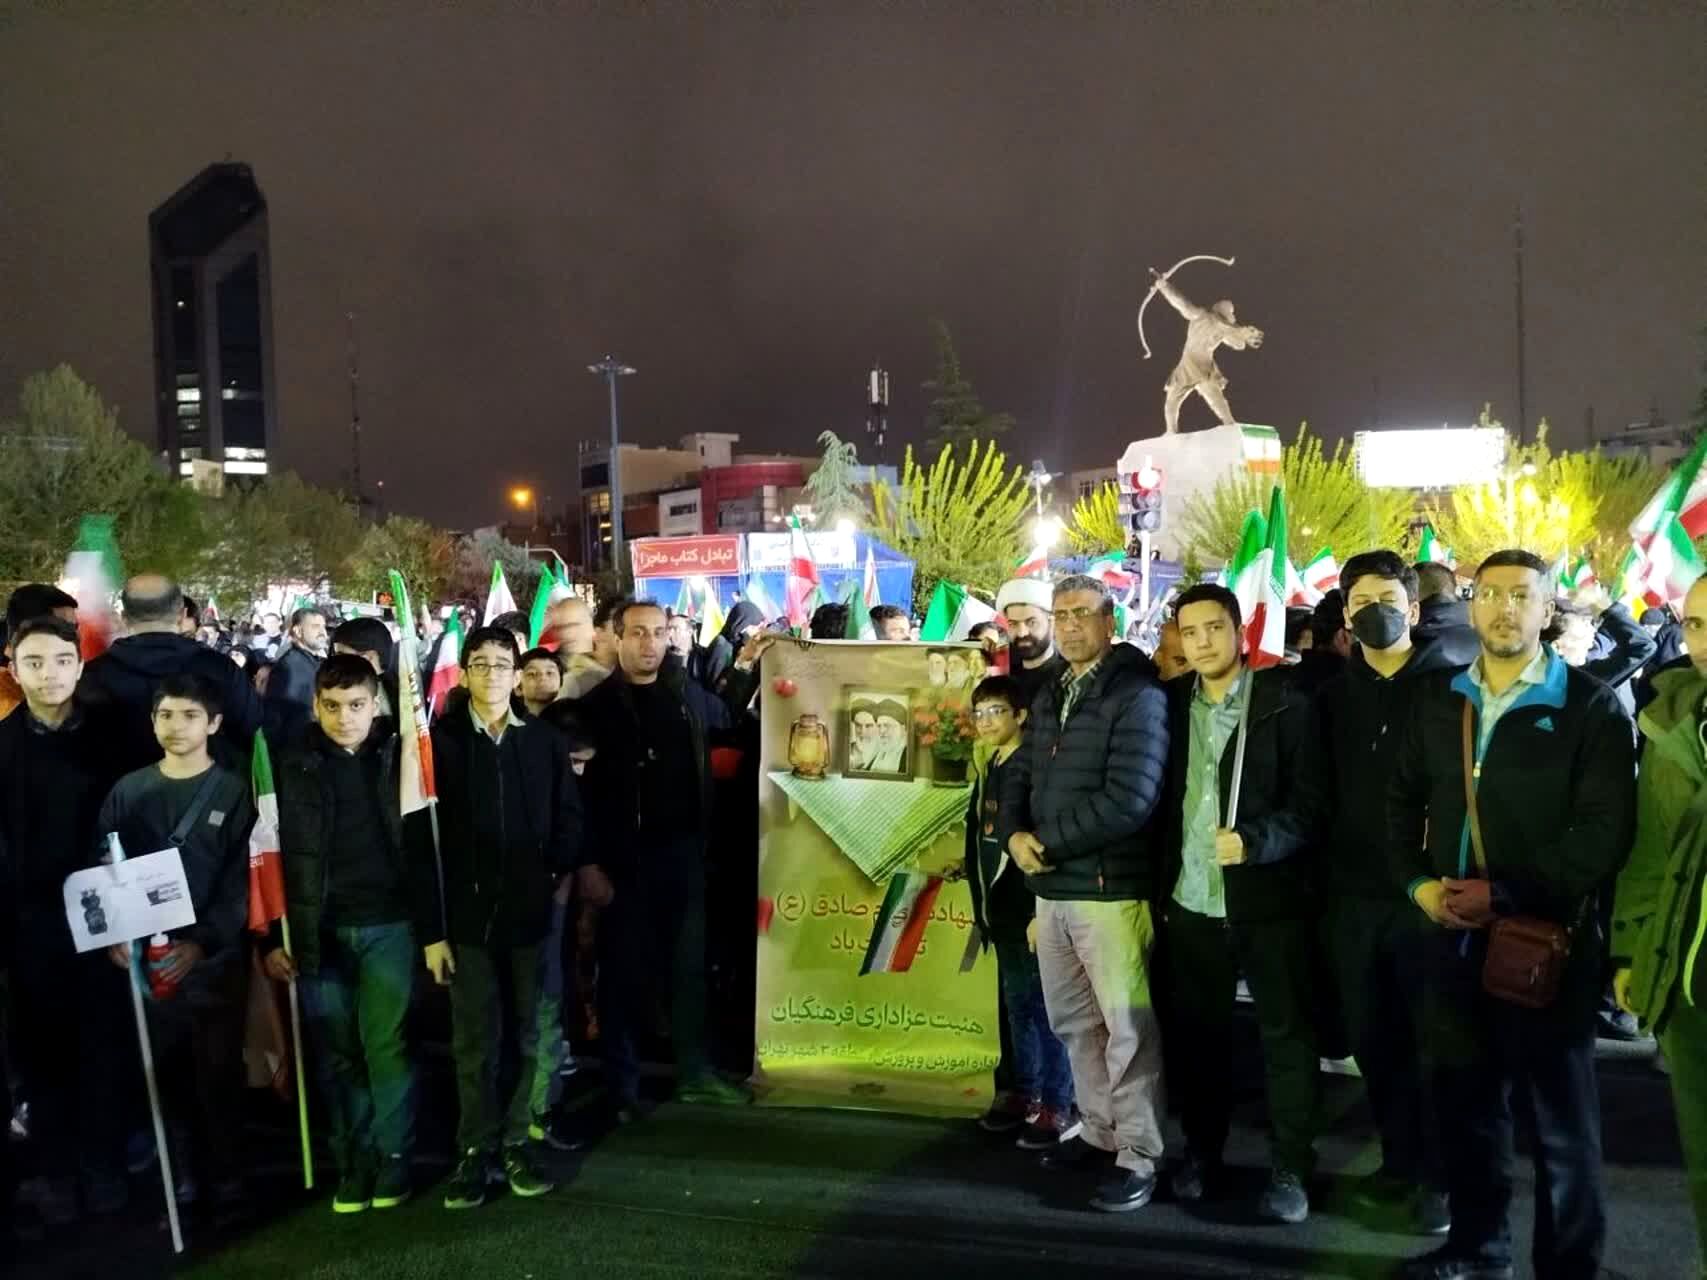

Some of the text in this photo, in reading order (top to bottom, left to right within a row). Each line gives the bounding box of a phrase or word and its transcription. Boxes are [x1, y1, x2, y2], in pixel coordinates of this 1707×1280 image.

[670, 548, 699, 567] کتاب
[701, 547, 734, 566] تبادل
[776, 889, 806, 922] (ع)
[811, 893, 868, 918] صادق
[830, 928, 855, 956] باد
[771, 995, 855, 1027] فرهنگیان
[856, 1002, 927, 1032] عزاداری
